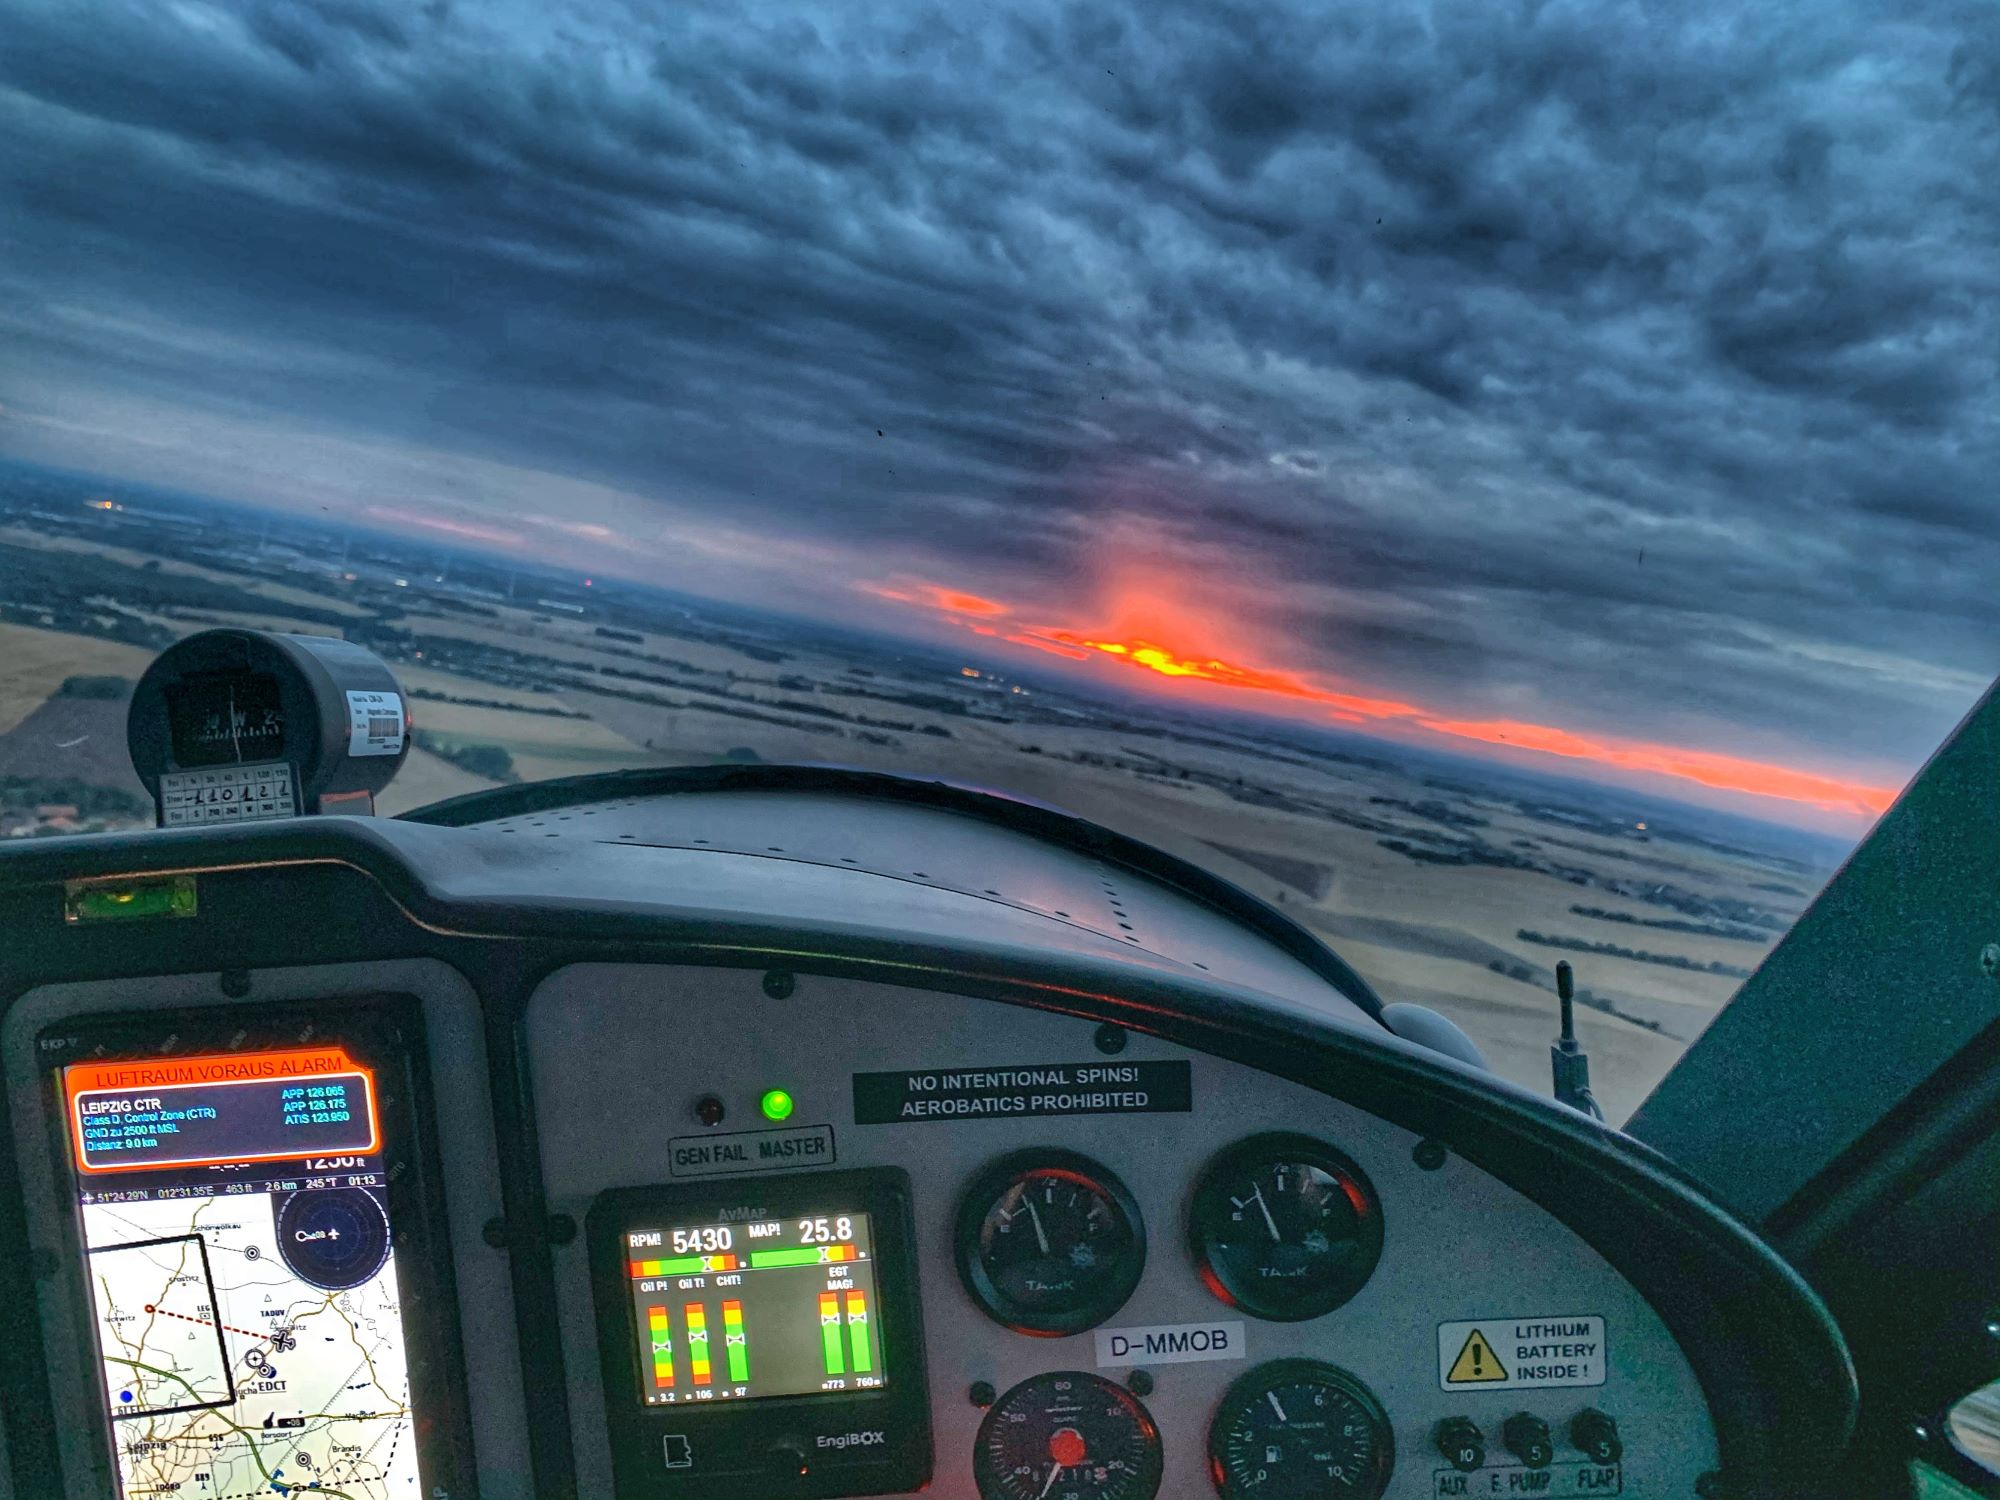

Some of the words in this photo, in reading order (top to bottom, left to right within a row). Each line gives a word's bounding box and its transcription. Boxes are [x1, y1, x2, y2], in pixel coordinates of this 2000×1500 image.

[96, 1067, 193, 1087] LUFTRAUM
[198, 1062, 274, 1080] VORAUS
[280, 1057, 342, 1074] ALARM
[909, 1076, 937, 1092] NO
[943, 1070, 1070, 1089] INTENTIONAL
[1076, 1067, 1140, 1083] SPINS!
[282, 1089, 304, 1100] APP
[81, 1100, 132, 1114] LEIPZIG
[134, 1098, 161, 1111] CTR
[283, 1101, 306, 1112] APP
[308, 1099, 347, 1110] 126.175
[901, 1096, 1026, 1116] AEROBATICS
[1031, 1092, 1149, 1109] PROHIBITED
[83, 1116, 111, 1126] Class
[125, 1112, 158, 1123] Control
[160, 1111, 185, 1121] Zone
[187, 1107, 216, 1120] (CTR)
[285, 1114, 310, 1125] ATIS
[311, 1111, 350, 1122] 123.950
[85, 1128, 108, 1138] GND
[124, 1125, 148, 1136] 2500
[149, 1125, 156, 1134] ft
[157, 1123, 180, 1134] MSL
[142, 1138, 158, 1147] km
[676, 1147, 710, 1165] GEN
[714, 1144, 748, 1162] FAIL
[760, 1137, 825, 1159] MASTER
[356, 1157, 366, 1167] ft
[225, 1184, 244, 1194] 463
[245, 1183, 253, 1193] ft
[282, 1181, 297, 1190] km
[306, 1180, 324, 1189] 245
[348, 1175, 376, 1186] 01:13
[1232, 1212, 1243, 1221] E
[1322, 1208, 1331, 1217] F
[748, 1223, 781, 1238] MAP!
[799, 1217, 853, 1243] 25.8
[1089, 1223, 1098, 1232] F
[630, 1233, 662, 1247] RPM!
[673, 1227, 732, 1254] 5430
[829, 1266, 849, 1277] EGT
[678, 1279, 692, 1289] Oil
[716, 1275, 741, 1286] CHT!
[827, 1279, 854, 1290] MAG!
[641, 1282, 655, 1292] Oil
[1516, 1323, 1589, 1339] LITHIUM
[1111, 1330, 1228, 1357] D-MMOB
[1517, 1343, 1596, 1359] BATTERY
[1517, 1365, 1577, 1380] INSIDE
[258, 1380, 287, 1392] EDCT
[660, 1393, 675, 1402] 3.2
[696, 1390, 713, 1400] 106
[735, 1387, 747, 1397] 97
[827, 1379, 845, 1389] 773
[856, 1378, 874, 1387] 760
[1314, 1395, 1323, 1406] 6
[1106, 1407, 1122, 1417] 10
[1244, 1431, 1253, 1442] 2
[1344, 1425, 1353, 1436] 8
[816, 1430, 885, 1449] EngiBOX
[333, 1445, 361, 1453] Brandis
[1531, 1446, 1542, 1460] 5
[1599, 1442, 1610, 1457] 5
[1459, 1449, 1474, 1462] 10
[1014, 1466, 1031, 1475] 40
[1108, 1460, 1124, 1469] 20
[1258, 1469, 1267, 1480] 0
[1327, 1466, 1342, 1476] 10
[1439, 1474, 1468, 1495] AUX
[1510, 1472, 1551, 1491] PUMP
[1578, 1469, 1615, 1488] FLAP
